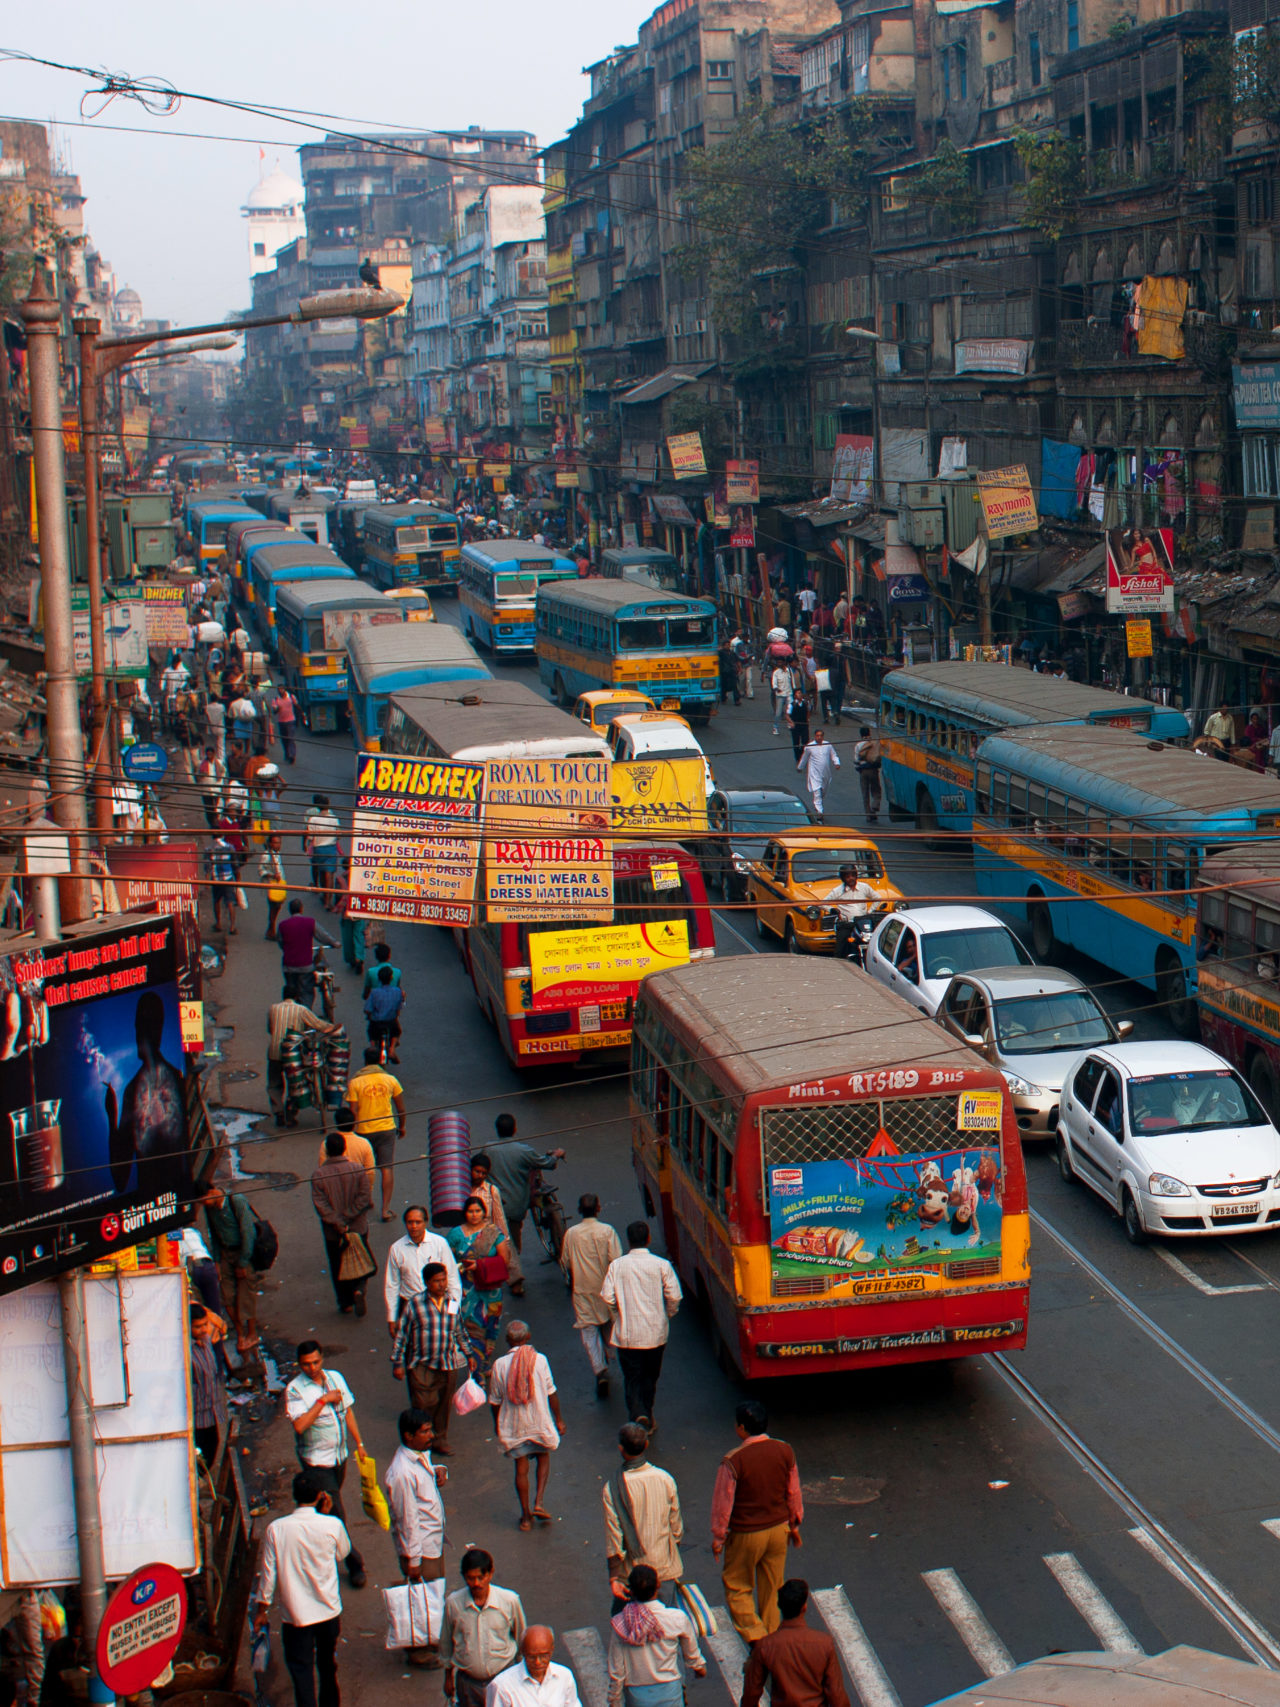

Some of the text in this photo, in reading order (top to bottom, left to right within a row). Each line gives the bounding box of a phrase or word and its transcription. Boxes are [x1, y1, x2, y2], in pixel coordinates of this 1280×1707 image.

[987, 495, 1031, 515] Raymond
[1121, 577, 1160, 591] Ashok
[358, 758, 483, 801] ABHISHEK
[489, 763, 609, 783] ROYAL TOUCH
[488, 789, 562, 805] CREATIONS
[566, 789, 582, 806] (P)
[393, 818, 434, 831] HOUSE
[357, 842, 393, 855] DHOTI
[494, 837, 606, 872] Raymond
[353, 856, 473, 877] SUIT & PARTY DRESS
[382, 872, 461, 889] Burtolla Street
[497, 873, 600, 885] ETHNIC WEAR &
[366, 883, 384, 893] 3rd
[421, 889, 440, 899] Kol
[490, 887, 609, 899] DRESS MATERIALS
[351, 897, 361, 910] Ph
[367, 899, 390, 913] 98301
[391, 901, 415, 916] 84432
[420, 904, 444, 919] 98301
[445, 907, 469, 922] 33456
[15, 951, 68, 983] Smokers'
[68, 947, 100, 972] lungs
[100, 942, 118, 964] are
[120, 935, 139, 959] full
[139, 932, 150, 954] of
[44, 965, 148, 1007] that causes cancer
[565, 985, 592, 997] GOLD
[788, 1071, 964, 1098] Mini Bus
[964, 1100, 977, 1115] AV
[963, 1116, 998, 1129] 9830241012
[835, 1205, 862, 1214] CAKES
[1214, 1205, 1226, 1216] WB
[1241, 1204, 1259, 1213] 7327
[122, 1204, 178, 1234] QUIT TODAY
[828, 1257, 854, 1268] bhara
[953, 1327, 1003, 1341] Please
[111, 1598, 176, 1641] NO ENTRY EXCEPT
[110, 1635, 133, 1653] BUSES
